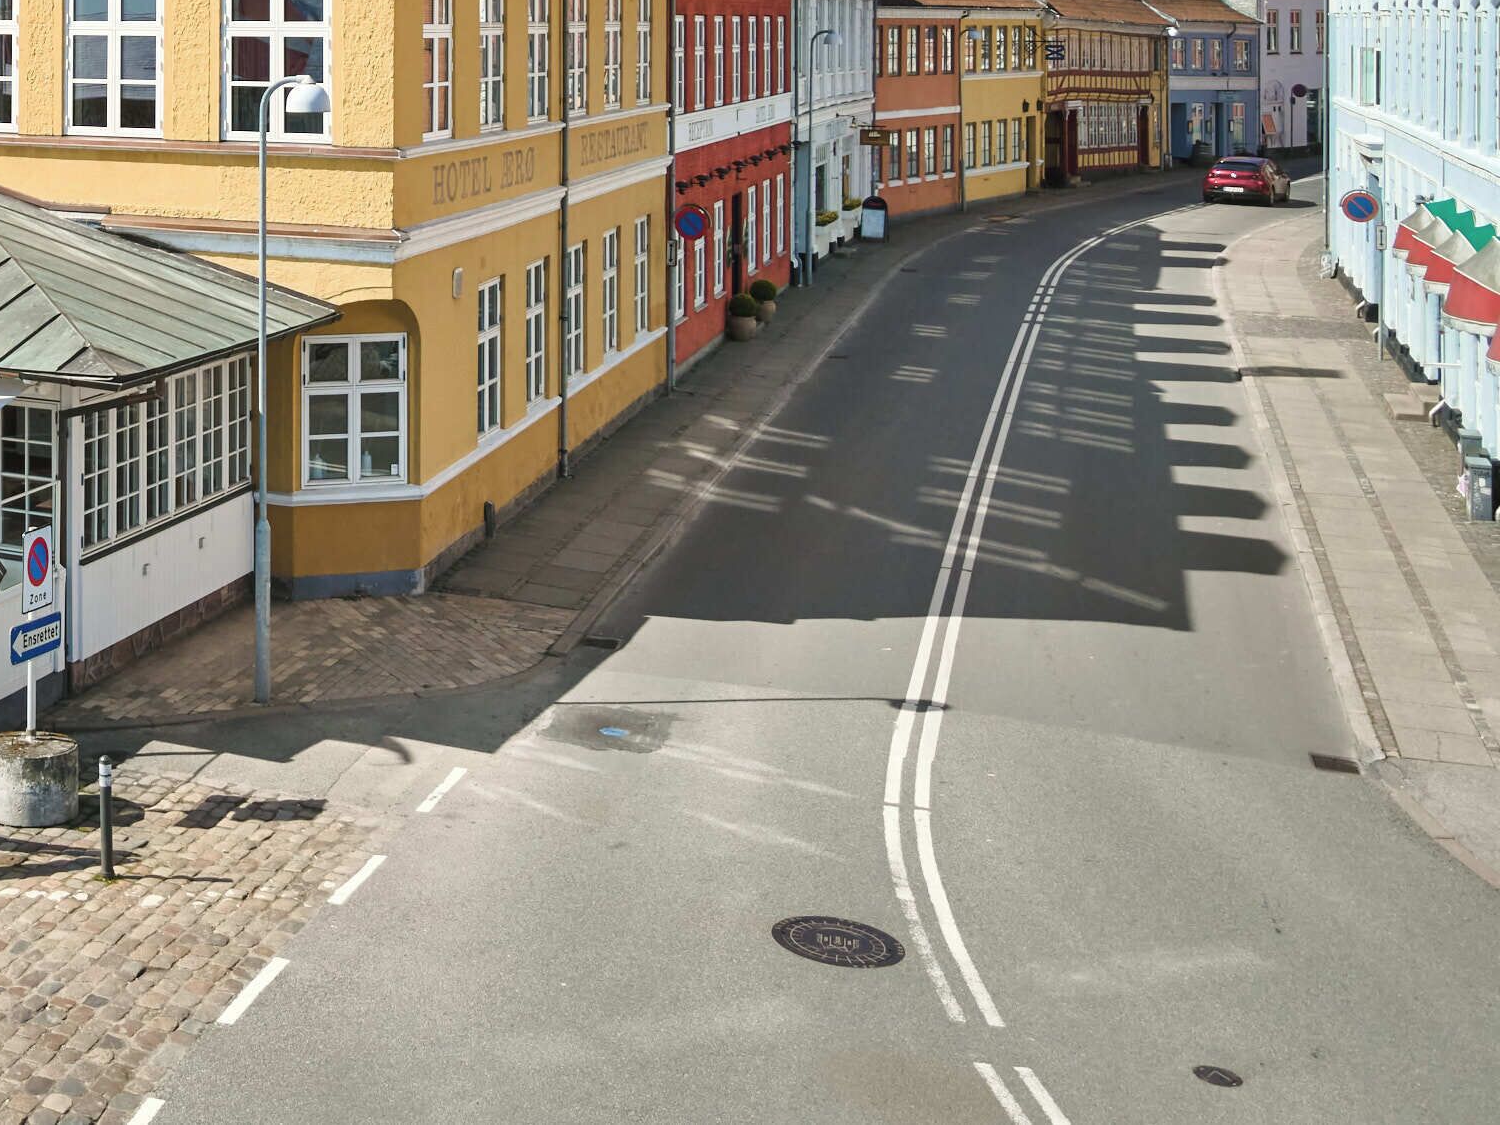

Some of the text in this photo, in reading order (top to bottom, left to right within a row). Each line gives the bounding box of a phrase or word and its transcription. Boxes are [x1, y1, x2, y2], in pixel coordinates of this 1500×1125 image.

[580, 121, 649, 166] RESTAURANT
[432, 146, 536, 205] HOTEL ÆRØ
[29, 591, 47, 605] Zone
[23, 623, 59, 649] Ensrettet
